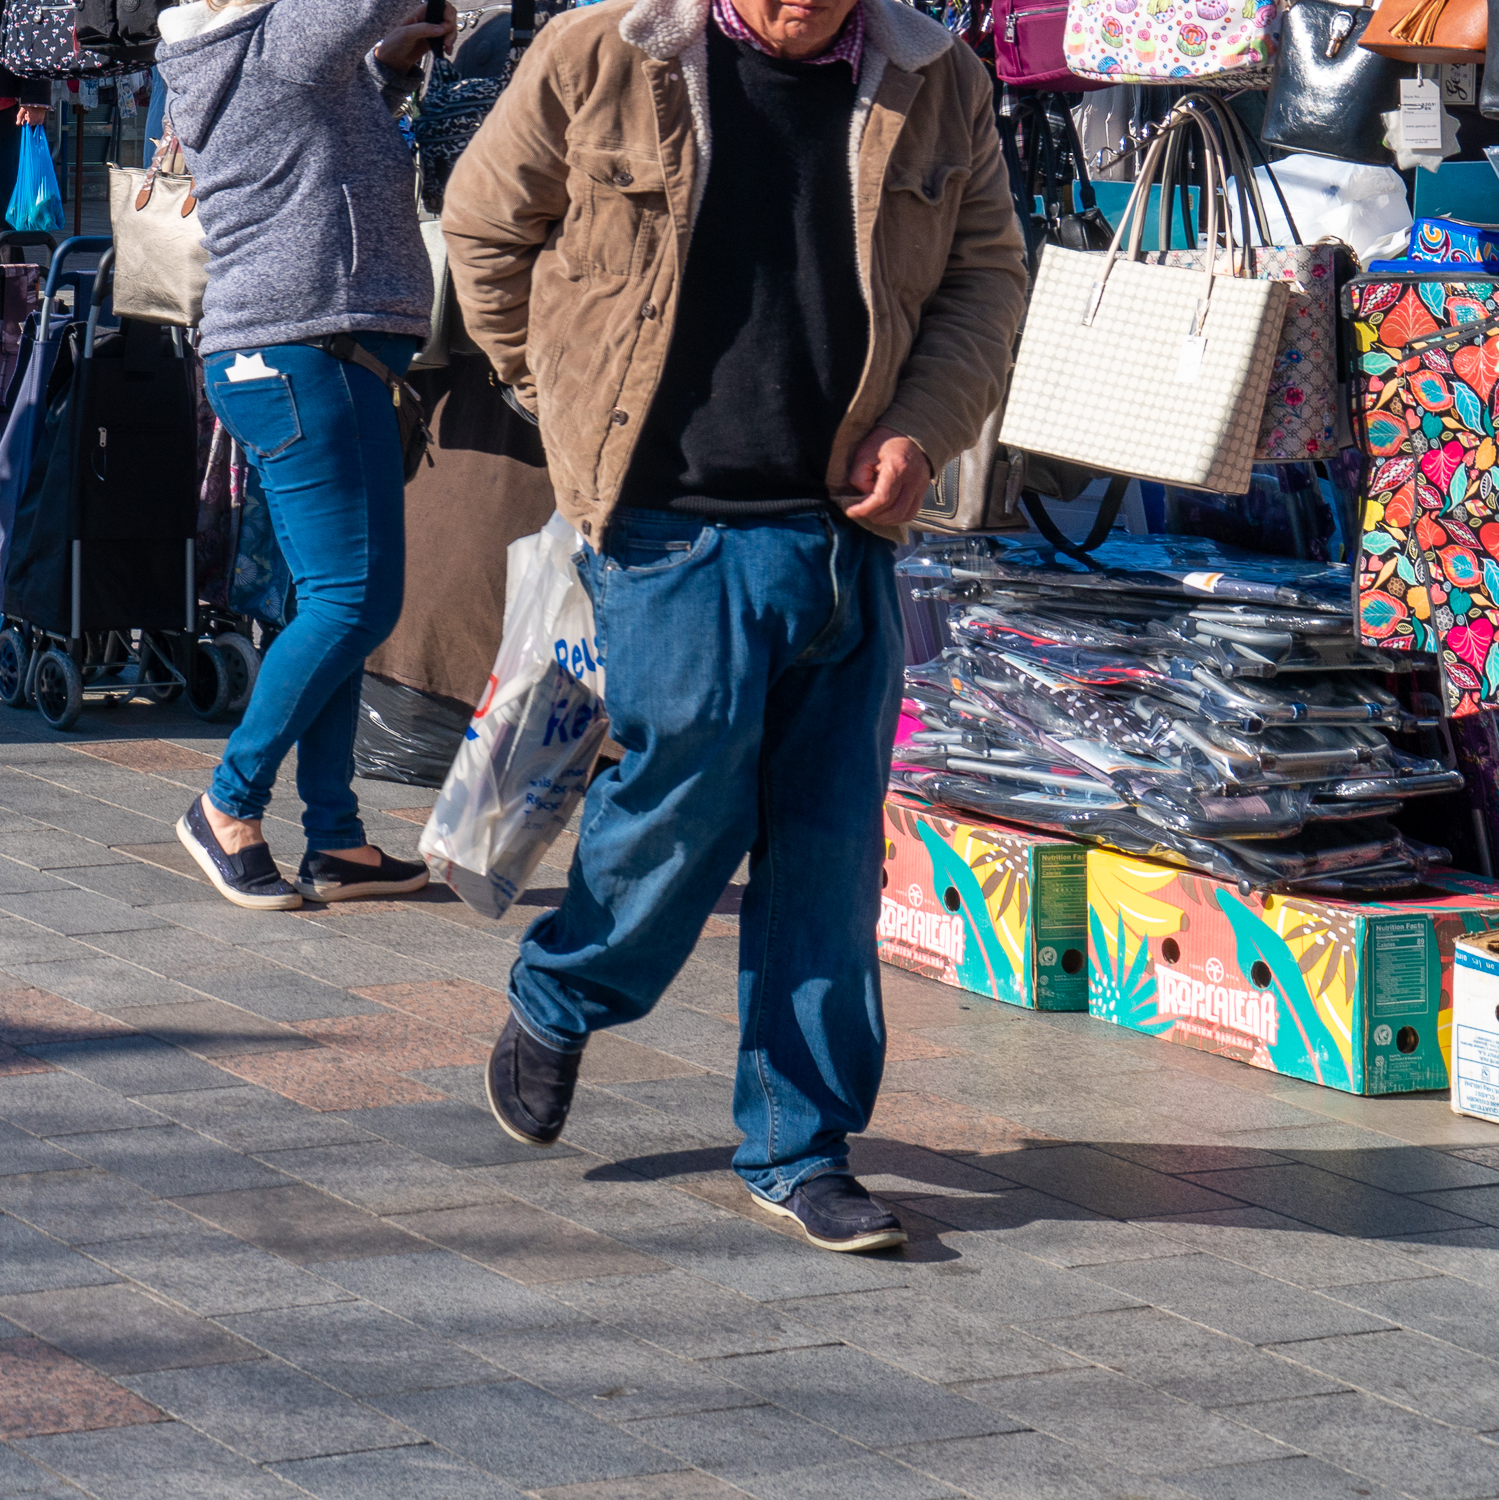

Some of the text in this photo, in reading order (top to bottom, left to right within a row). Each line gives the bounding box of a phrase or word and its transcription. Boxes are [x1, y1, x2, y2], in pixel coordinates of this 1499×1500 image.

[1041, 853, 1087, 861] Nutrition Fac
[1375, 922, 1425, 932] Nutrition Facts
[1376, 938, 1425, 949] Calories 89
[1175, 1020, 1254, 1050] PREMIUM BANANAS
